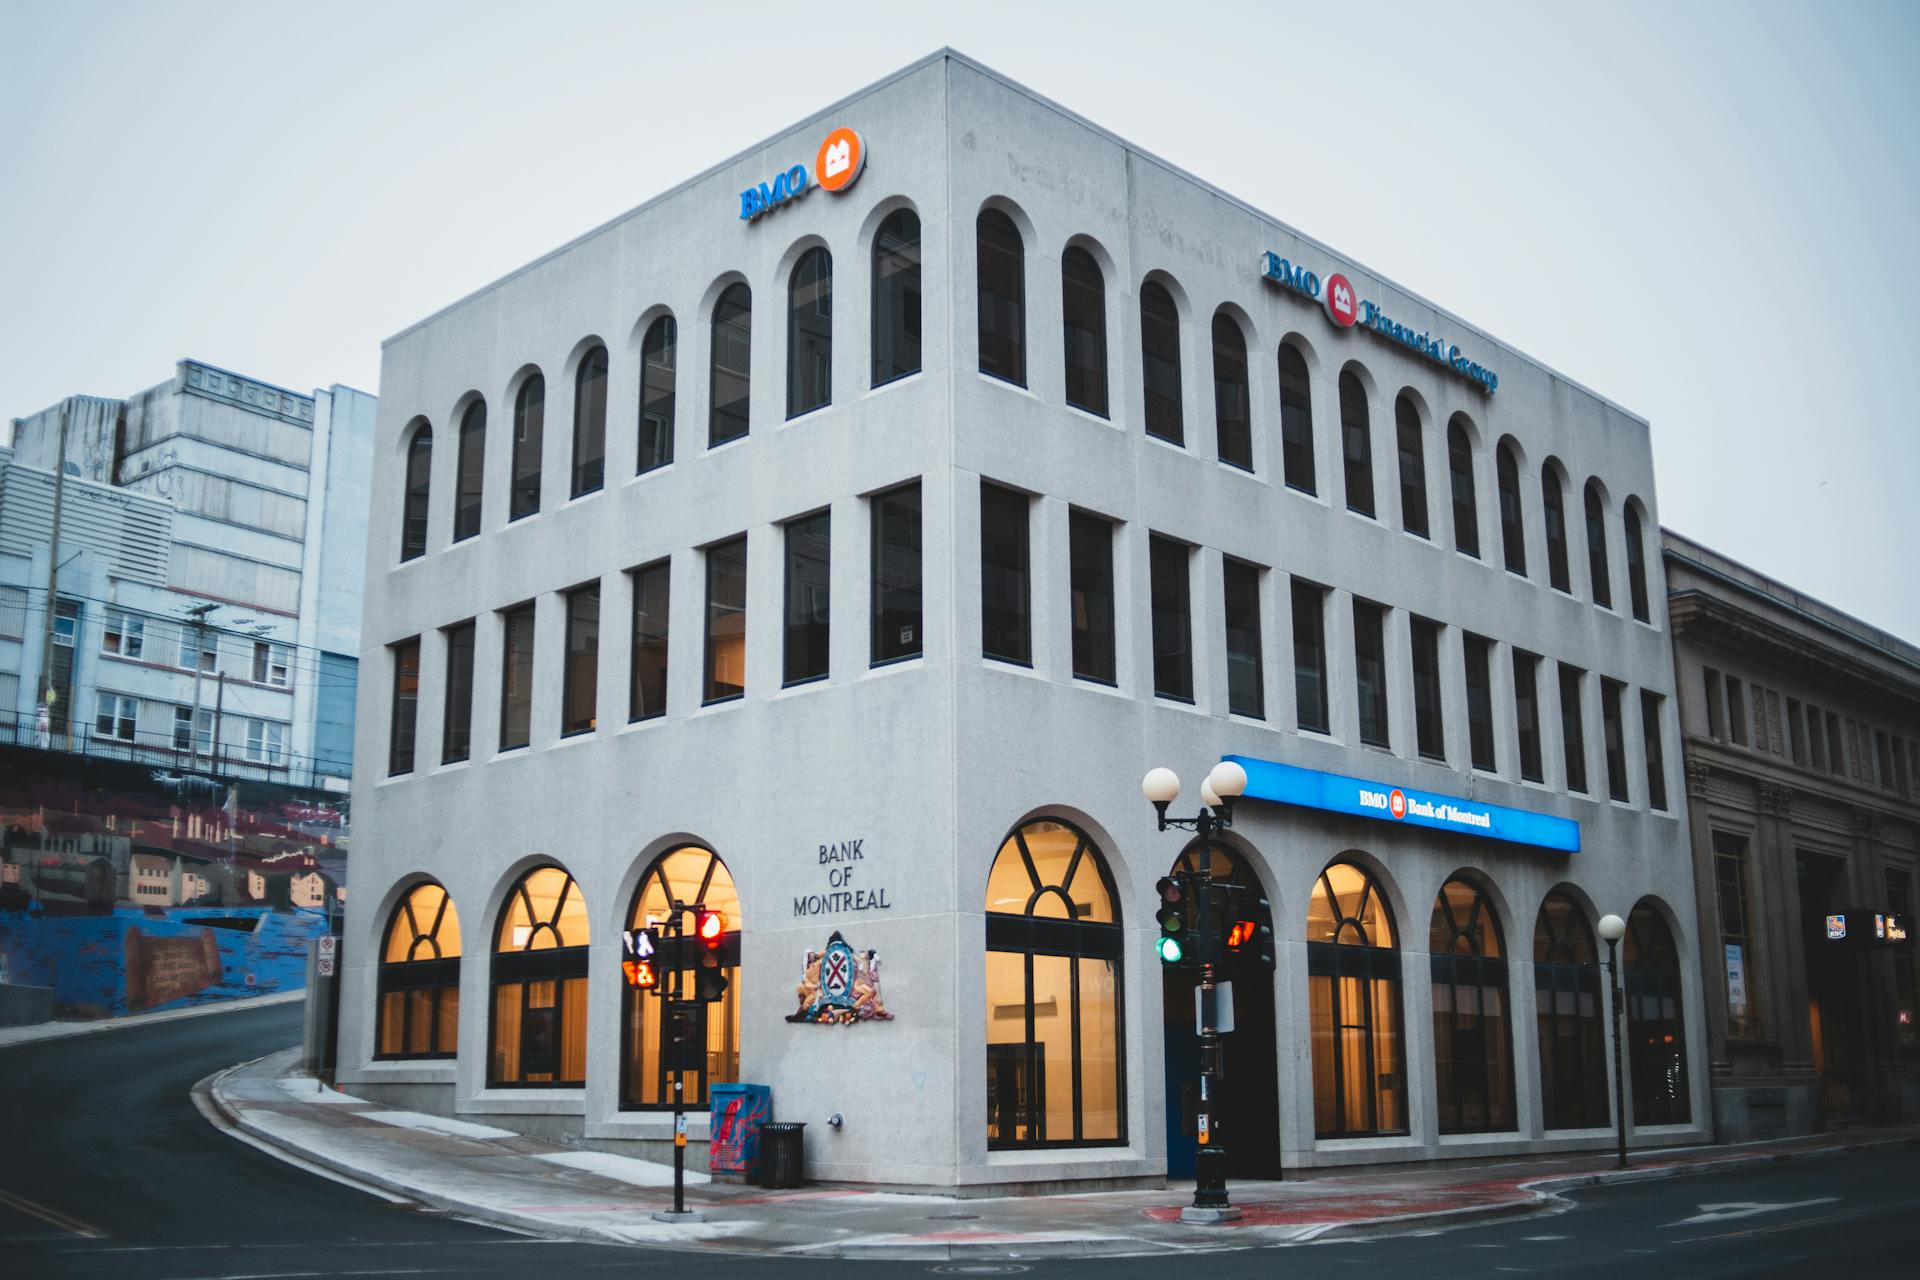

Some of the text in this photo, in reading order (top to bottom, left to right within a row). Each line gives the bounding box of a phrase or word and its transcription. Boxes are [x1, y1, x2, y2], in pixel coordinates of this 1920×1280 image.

[739, 164, 807, 220] BMO
[1263, 250, 1499, 394] BMO Financial Group
[1359, 790, 1490, 828] BMO Bank of Montreal
[819, 839, 864, 864] BANK
[829, 866, 853, 888] OF
[794, 888, 891, 916] MONTREAL
